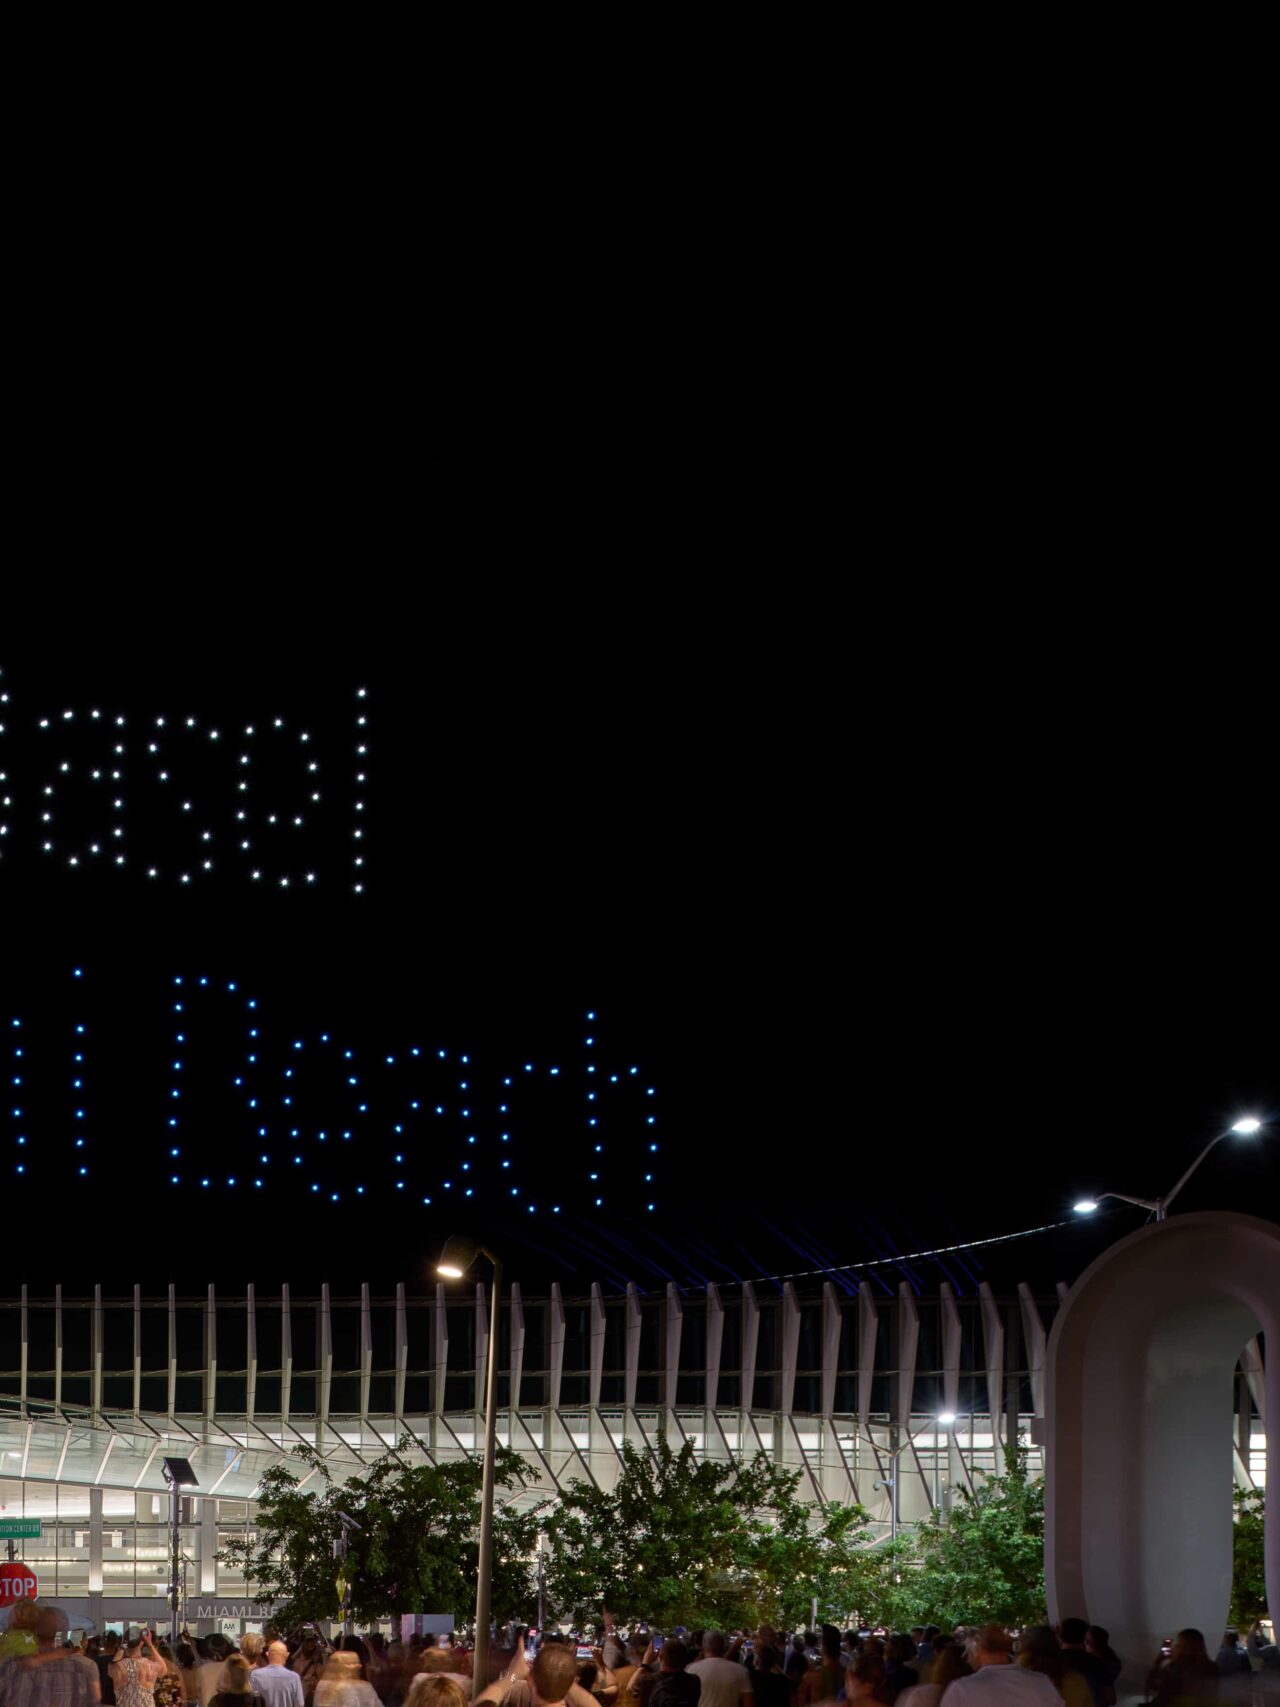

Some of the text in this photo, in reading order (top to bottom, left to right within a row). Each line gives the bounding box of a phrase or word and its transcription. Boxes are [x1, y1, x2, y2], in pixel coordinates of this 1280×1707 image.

[167, 975, 659, 1216] Beach
[13, 1524, 32, 1532] CENTER
[197, 1605, 252, 1618] MIAMI
